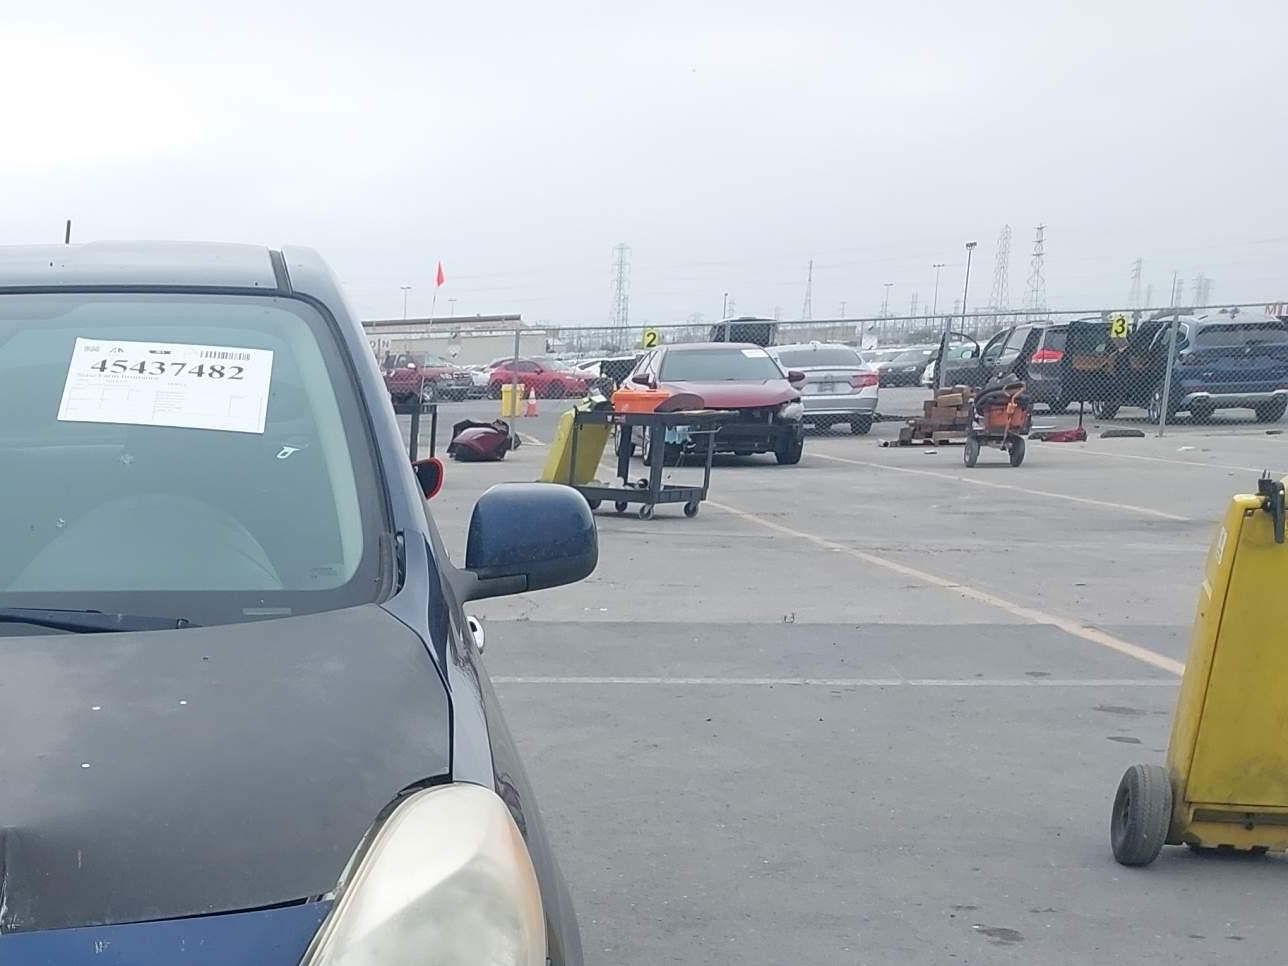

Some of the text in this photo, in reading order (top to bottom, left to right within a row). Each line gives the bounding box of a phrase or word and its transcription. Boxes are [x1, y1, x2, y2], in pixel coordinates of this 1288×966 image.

[1114, 318, 1126, 335] 3
[646, 332, 657, 347] 2
[90, 359, 244, 380] 45437482
